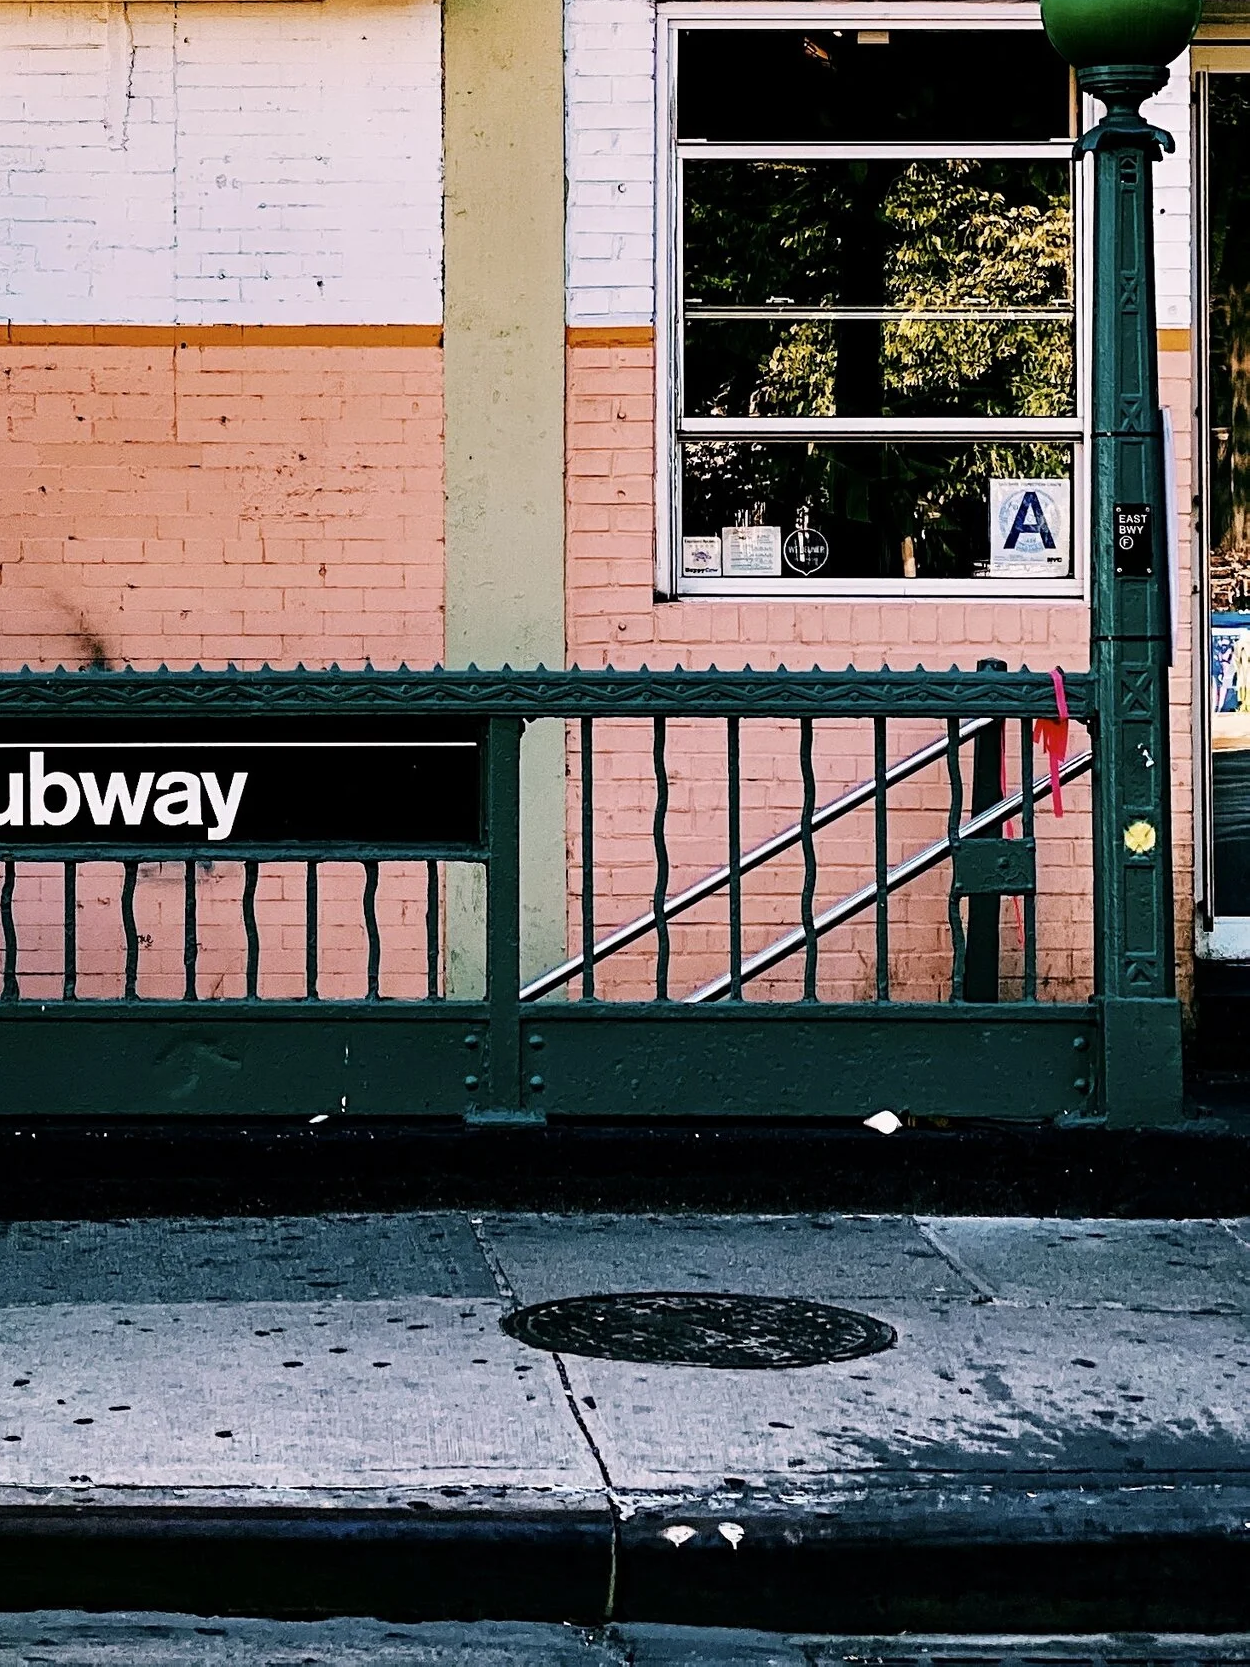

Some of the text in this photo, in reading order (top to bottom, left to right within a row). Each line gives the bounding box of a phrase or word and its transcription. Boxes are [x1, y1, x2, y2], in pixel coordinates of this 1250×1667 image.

[1003, 491, 1056, 549] A
[1118, 514, 1148, 524] EAST
[1119, 525, 1144, 535] BWY
